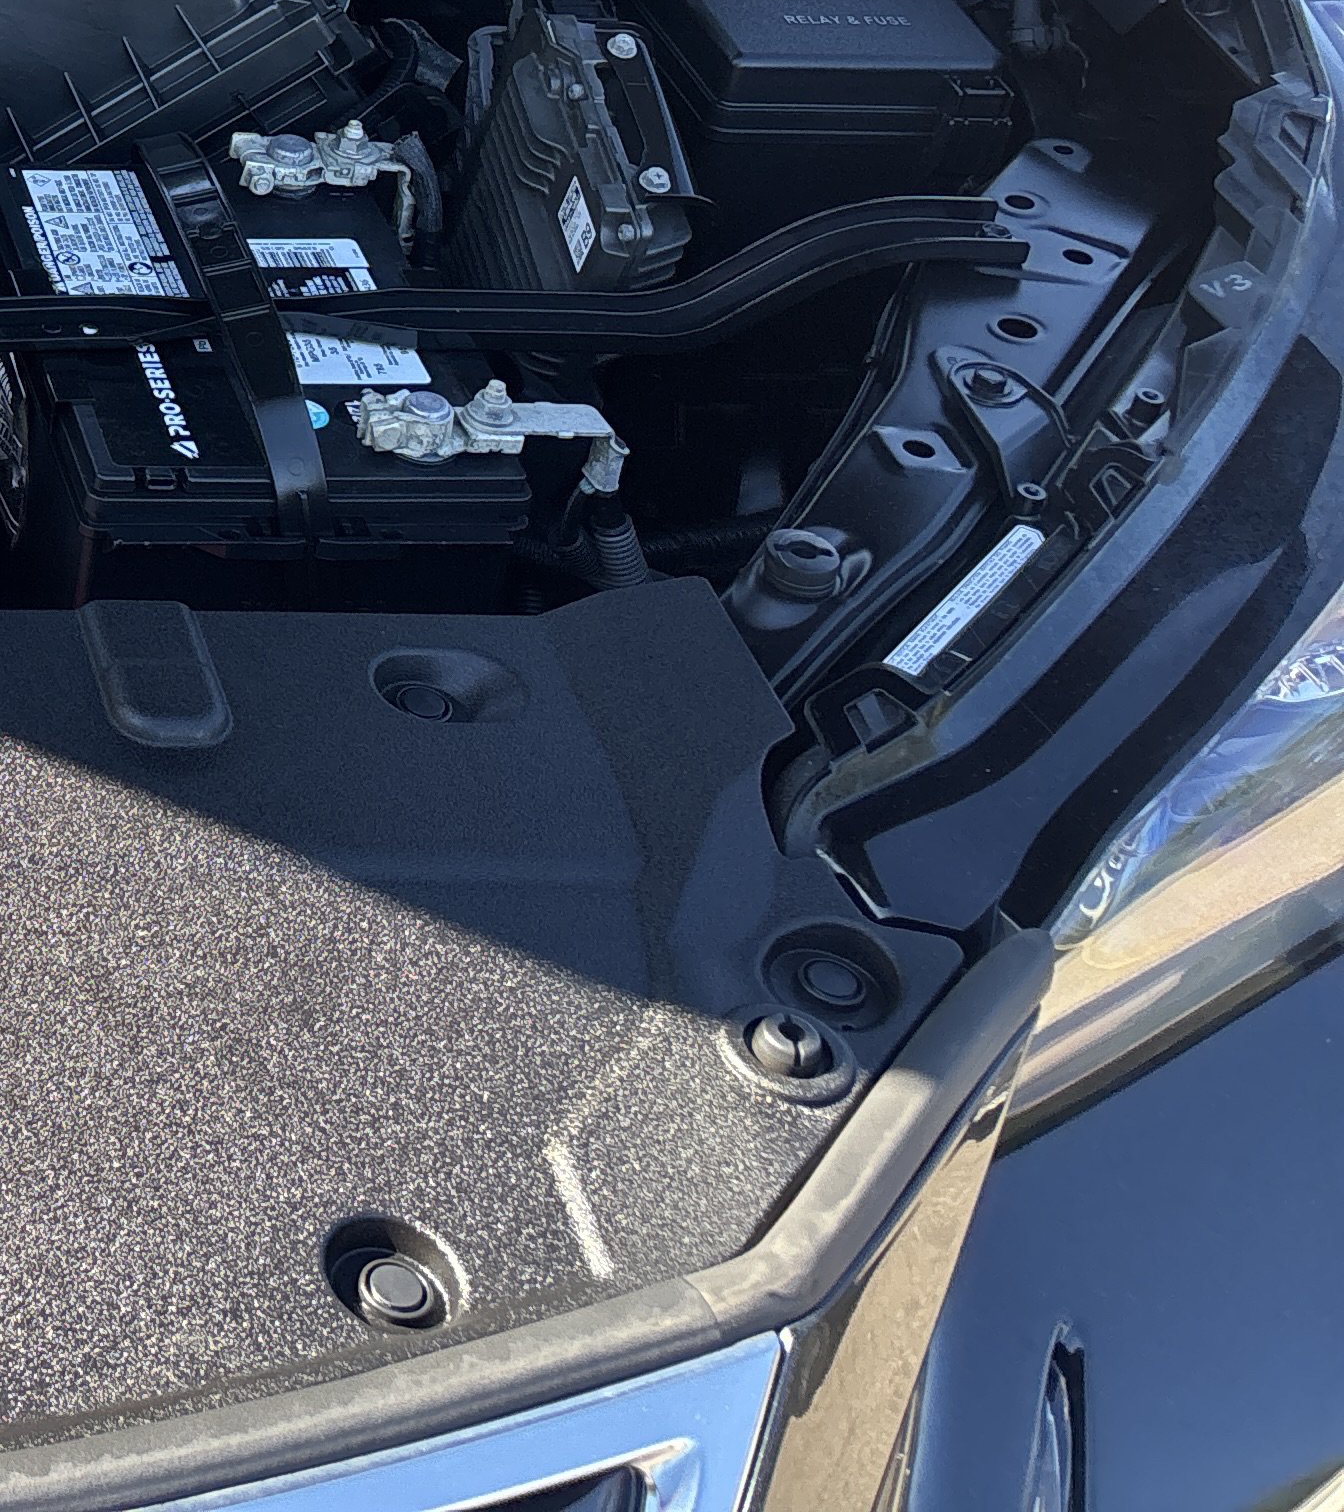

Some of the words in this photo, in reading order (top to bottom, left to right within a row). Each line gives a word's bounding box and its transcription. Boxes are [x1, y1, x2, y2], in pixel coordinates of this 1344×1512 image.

[783, 14, 841, 25] RELAY
[847, 14, 860, 25] &
[863, 15, 912, 26] FUSE
